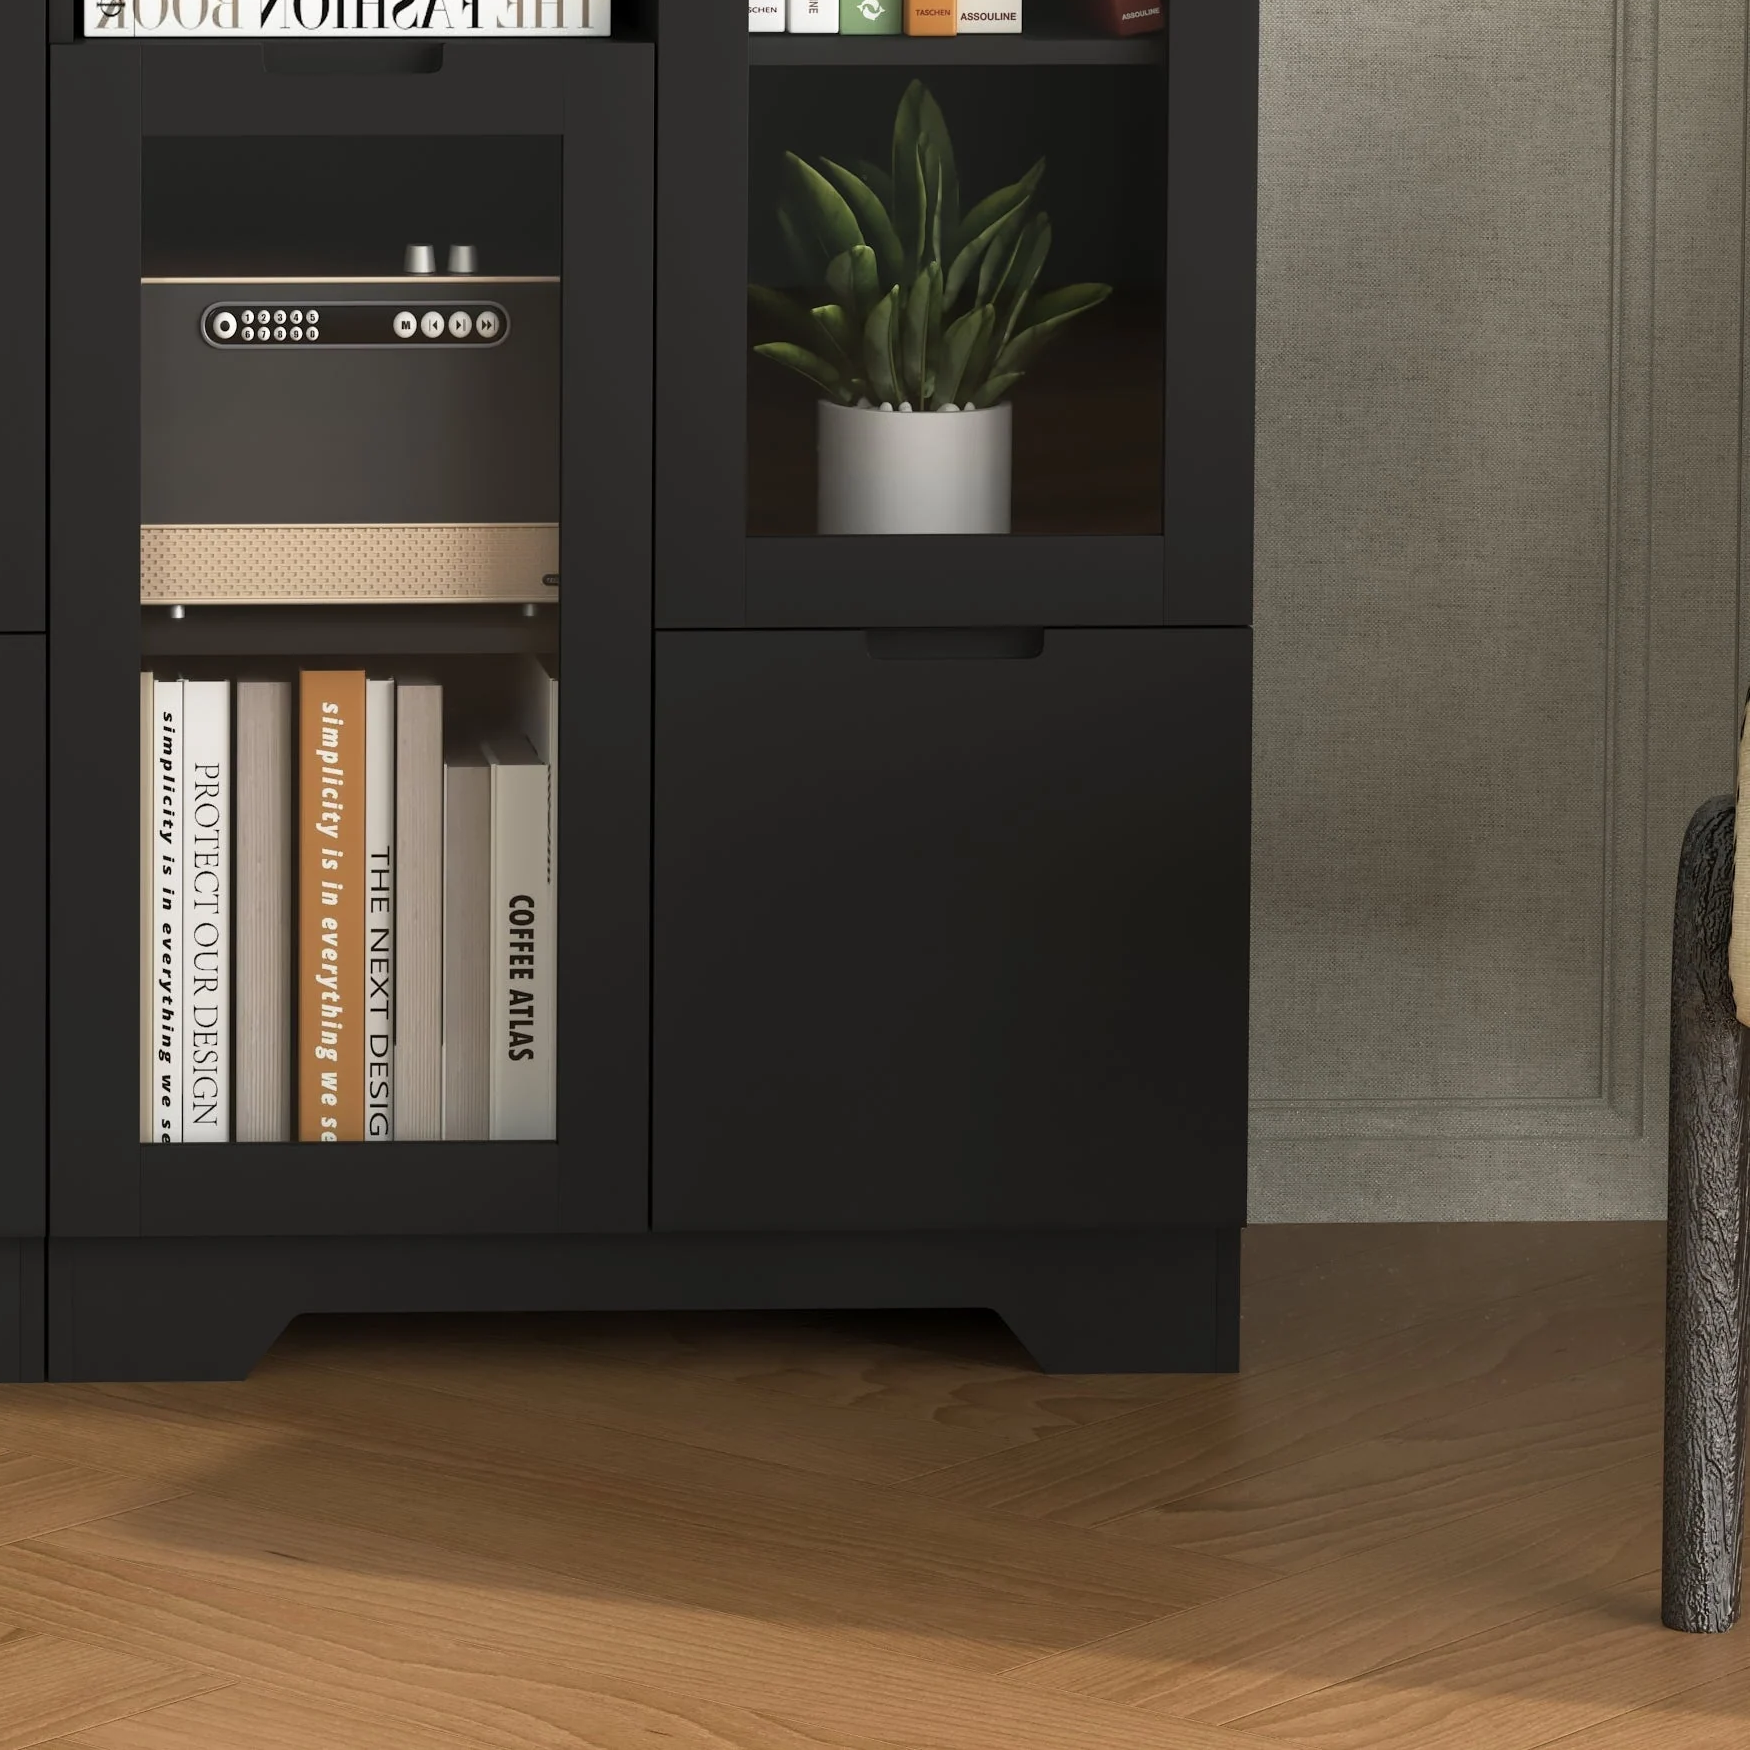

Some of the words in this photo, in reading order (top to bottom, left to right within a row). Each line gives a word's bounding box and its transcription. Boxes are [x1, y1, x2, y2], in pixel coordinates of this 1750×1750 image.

[748, 6, 778, 14] SCHEN
[915, 8, 951, 17] TASCHEN
[960, 11, 1017, 21] ASSOULINE
[1121, 6, 1161, 21] ASSOULINE
[245, 313, 250, 322] 1
[261, 313, 266, 322] 2
[277, 313, 283, 322] 3
[294, 313, 299, 322] 4
[310, 313, 315, 322] 5
[245, 330, 250, 338] 6
[261, 330, 266, 338] 7
[277, 330, 283, 338] 8
[294, 330, 299, 338] 9
[310, 330, 315, 338] 0
[401, 320, 411, 330] M
[159, 711, 176, 845] simplicity
[316, 702, 344, 839] simplicity
[194, 762, 220, 915] PROTECT
[162, 855, 175, 876] is
[321, 848, 344, 871] is
[321, 881, 344, 907] in
[370, 845, 390, 913] THE
[162, 886, 175, 911] in
[508, 894, 535, 981] COFFEE
[193, 922, 220, 997] OUR
[370, 927, 390, 1020] NEXT
[158, 922, 175, 1064] everything
[315, 917, 343, 1062] everything
[508, 989, 535, 1062] ATLAS
[192, 1006, 219, 1127] DESIGN
[161, 1075, 172, 1108] we
[321, 1073, 338, 1107] we
[369, 1034, 390, 1137] DESIG
